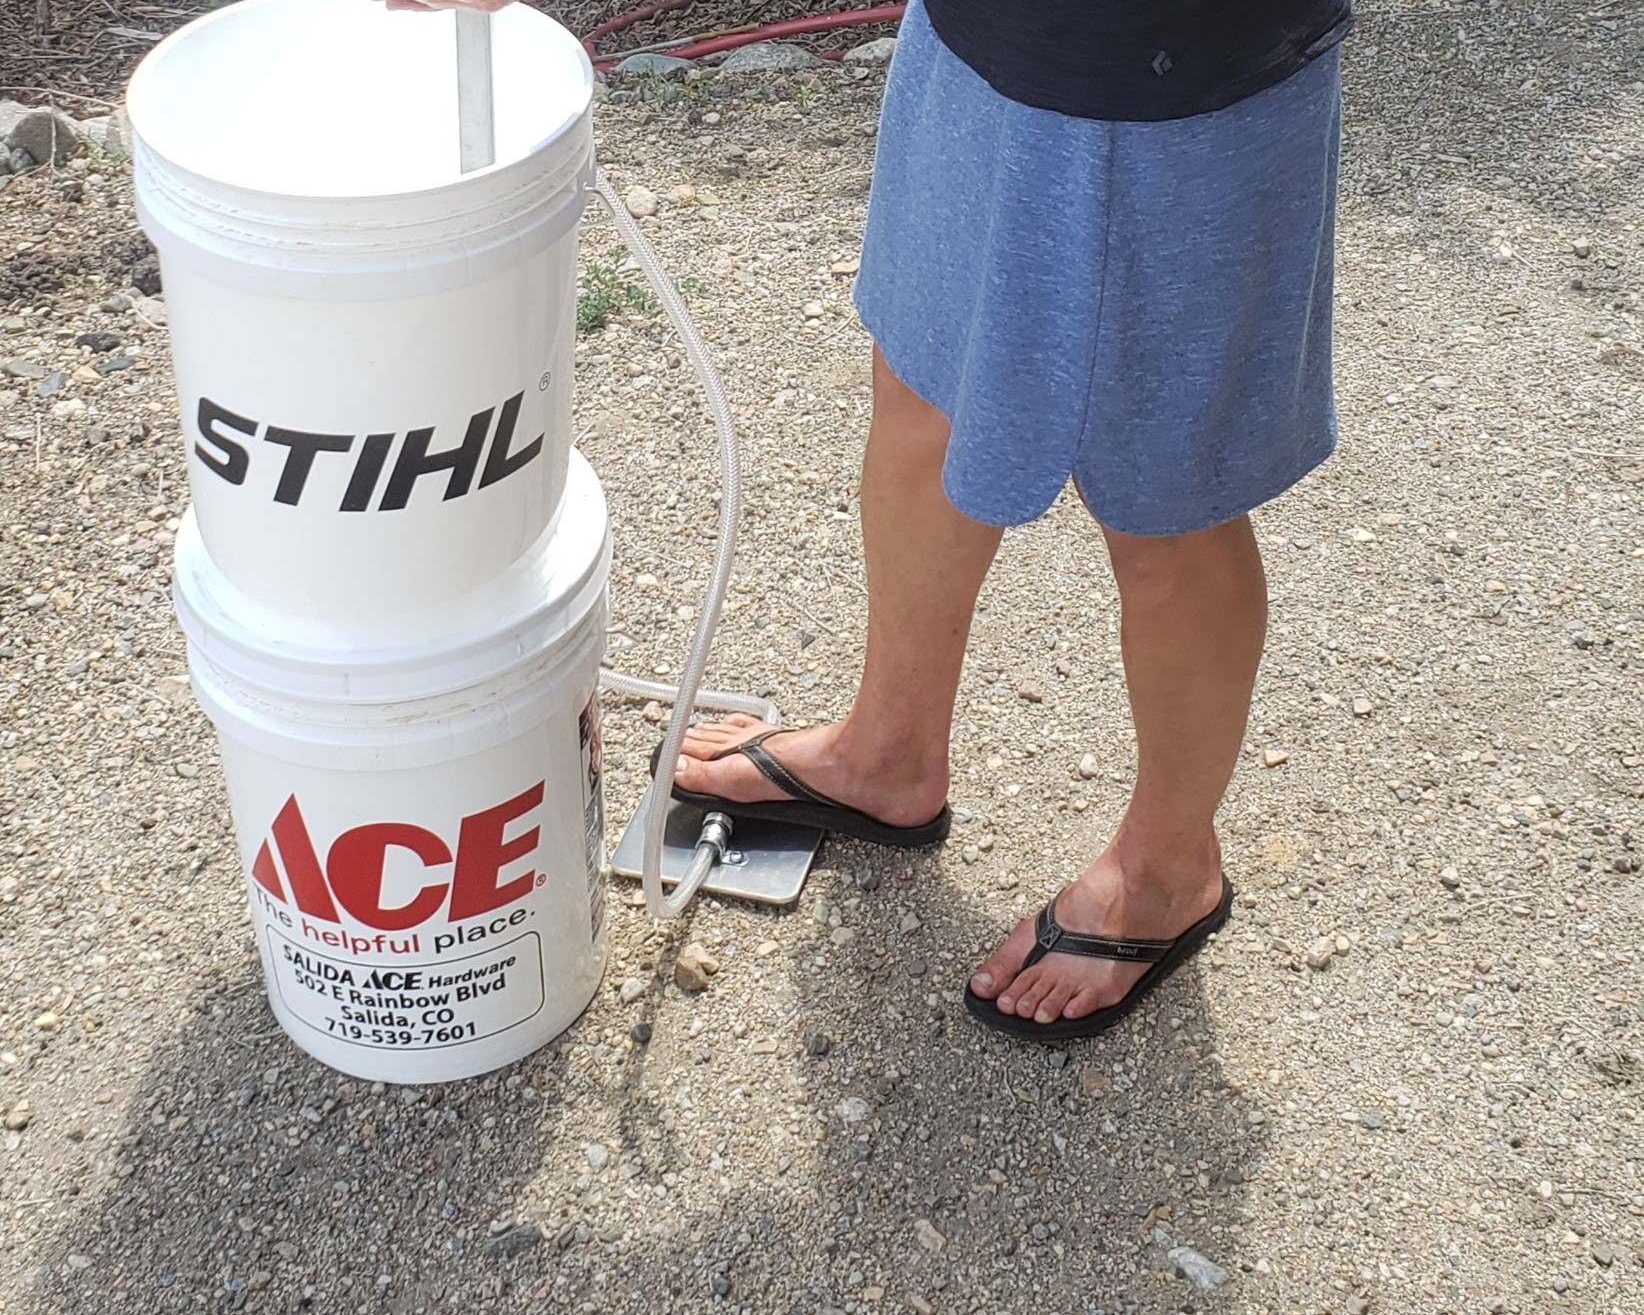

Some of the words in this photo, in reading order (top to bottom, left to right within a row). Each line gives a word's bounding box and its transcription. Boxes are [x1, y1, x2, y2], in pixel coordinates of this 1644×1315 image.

[195, 389, 545, 512] STIHL
[252, 779, 545, 931] ACE
[253, 882, 293, 928] The
[302, 918, 420, 955] helpful
[434, 907, 535, 954] place.
[283, 944, 355, 987] SALIDA
[362, 968, 423, 991] ACE
[428, 956, 516, 989] Hardware
[294, 969, 327, 996] 502
[332, 985, 345, 1002] E
[349, 989, 449, 1009] Rainbow
[456, 972, 506, 1002] Blvd
[324, 1016, 476, 1045] 719-539-7601
[341, 1005, 416, 1030] Salida,
[422, 1008, 454, 1025] CO
